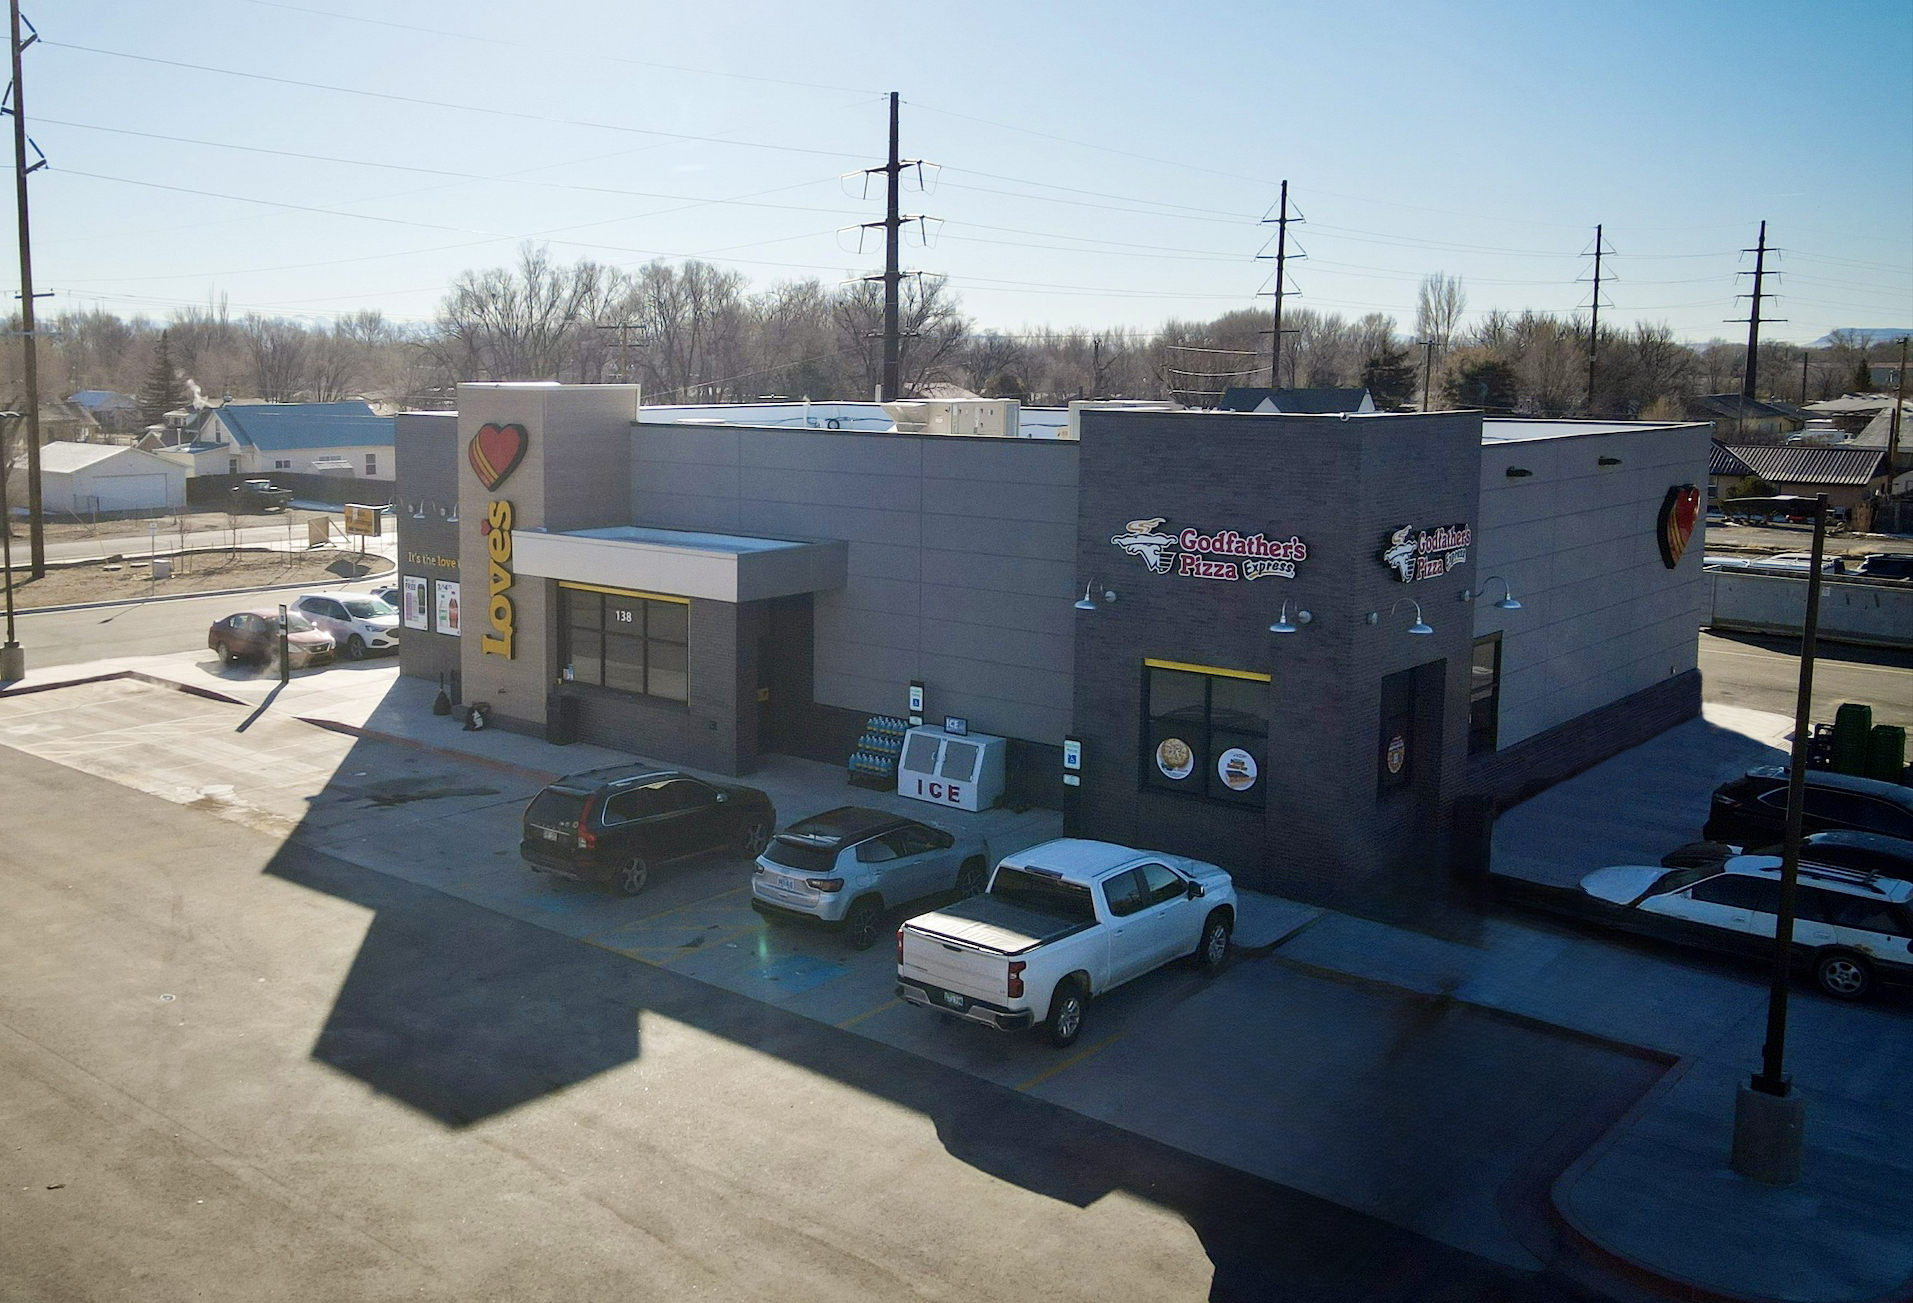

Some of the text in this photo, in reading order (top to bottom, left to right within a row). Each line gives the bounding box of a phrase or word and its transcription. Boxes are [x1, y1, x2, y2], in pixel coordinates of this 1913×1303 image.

[1180, 529, 1306, 560] Godfather's
[1418, 525, 1471, 554] Godfather's
[408, 552, 421, 563] It's
[423, 554, 436, 565] the
[437, 556, 457, 568] love
[1179, 554, 1294, 580] Pizza Express
[1417, 556, 1443, 580] Pizza
[615, 610, 632, 623] 138
[917, 779, 960, 803] ICE
